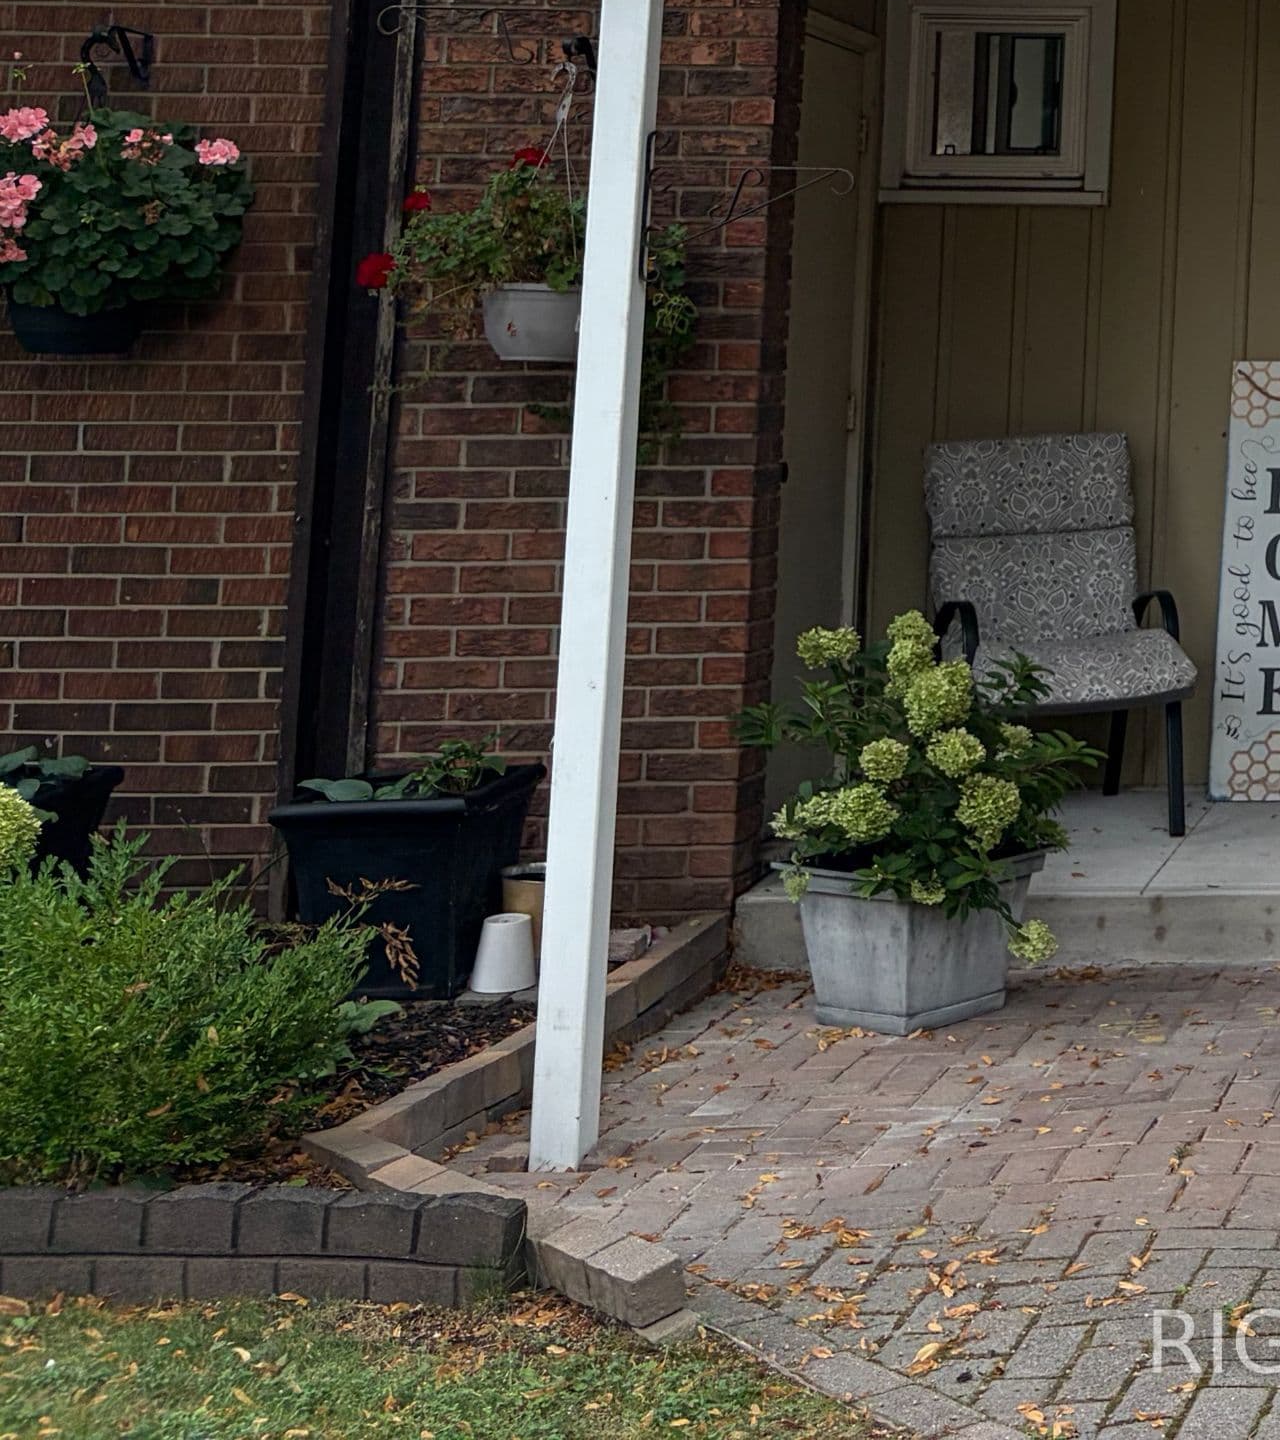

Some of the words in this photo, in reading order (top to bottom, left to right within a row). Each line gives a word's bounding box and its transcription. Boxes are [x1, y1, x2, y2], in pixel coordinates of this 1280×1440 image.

[1231, 461, 1258, 501] bee
[1232, 515, 1255, 549] to
[1230, 563, 1261, 636] good
[1220, 649, 1251, 702] It's
